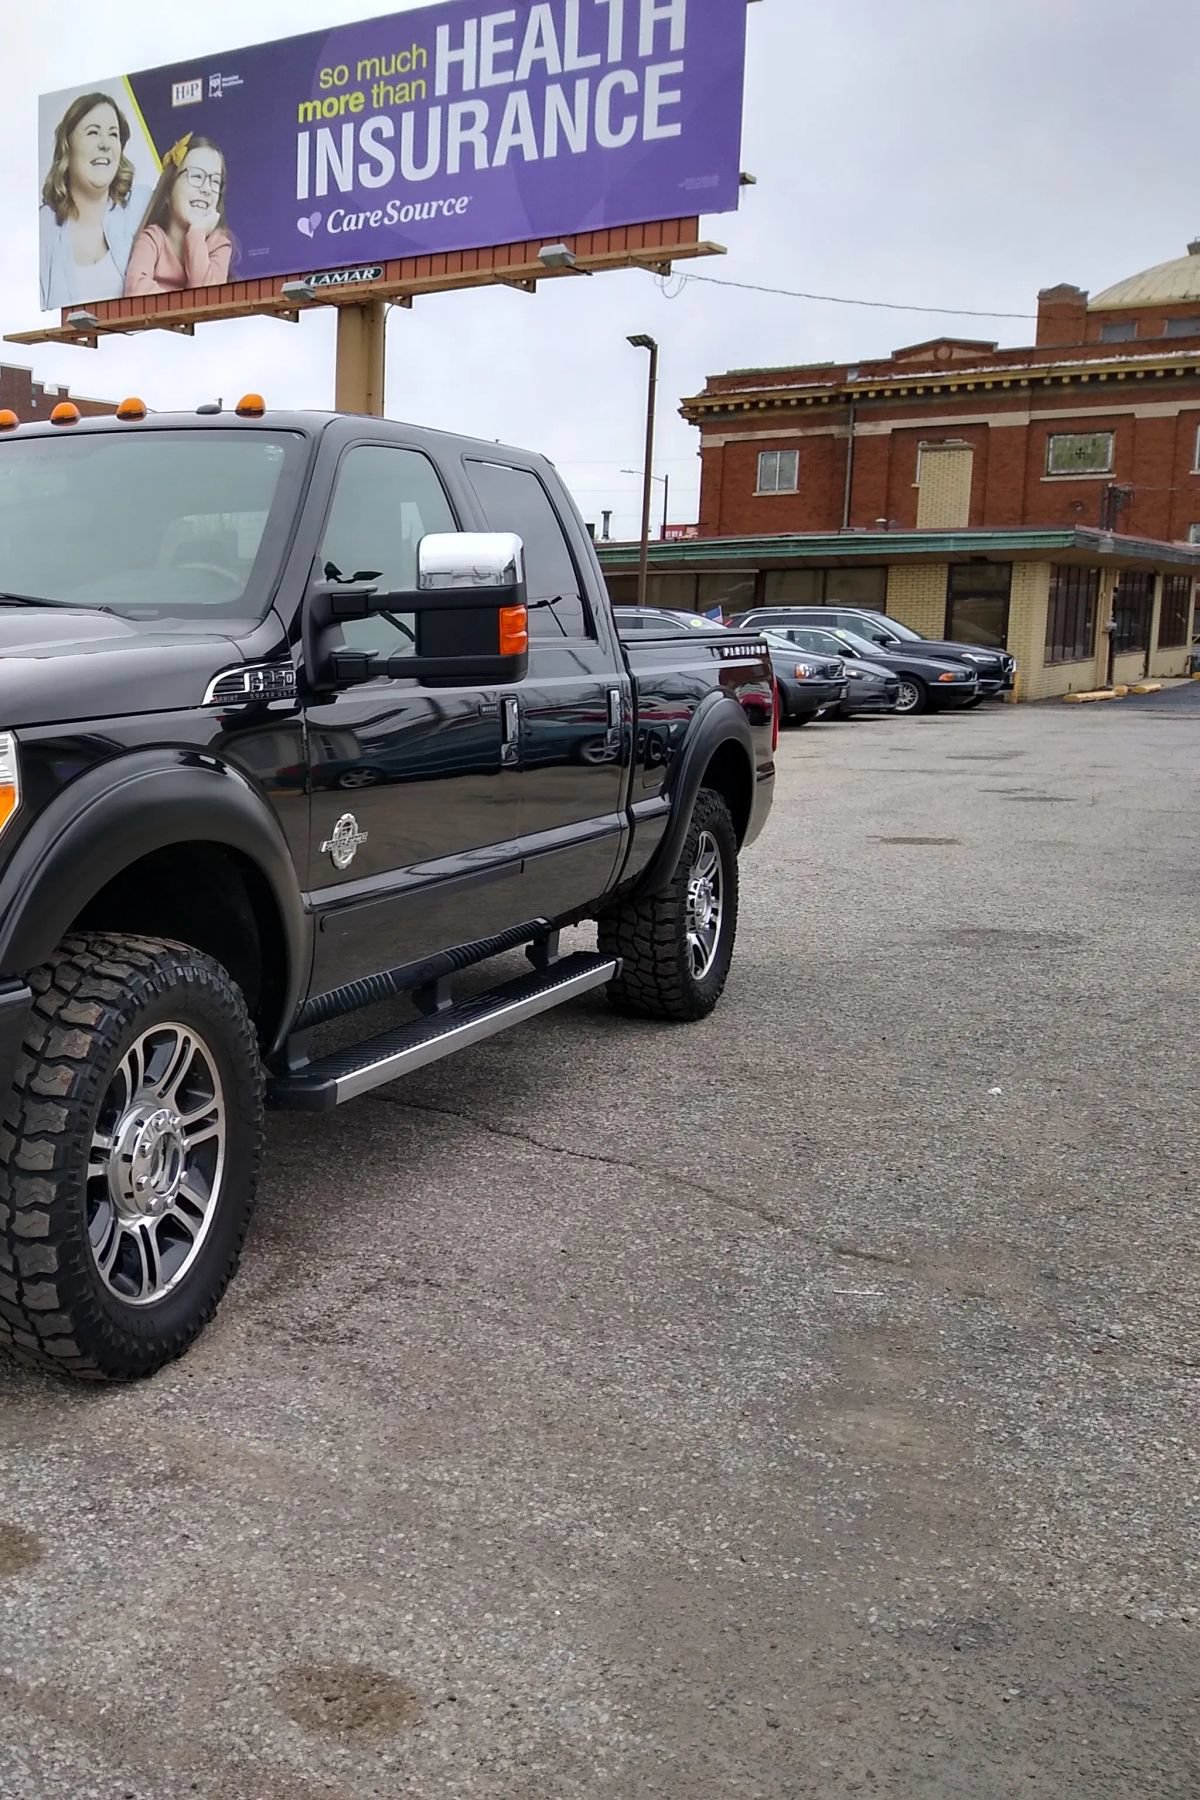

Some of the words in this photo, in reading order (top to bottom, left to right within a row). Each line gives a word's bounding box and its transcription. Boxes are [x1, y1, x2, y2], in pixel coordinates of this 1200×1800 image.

[319, 65, 349, 89] so
[357, 44, 427, 81] much
[435, 0, 686, 96] HEALTH
[298, 91, 365, 123] more
[371, 79, 426, 108] than
[297, 60, 684, 199] INSURANCE
[309, 268, 376, 286] LAMAR
